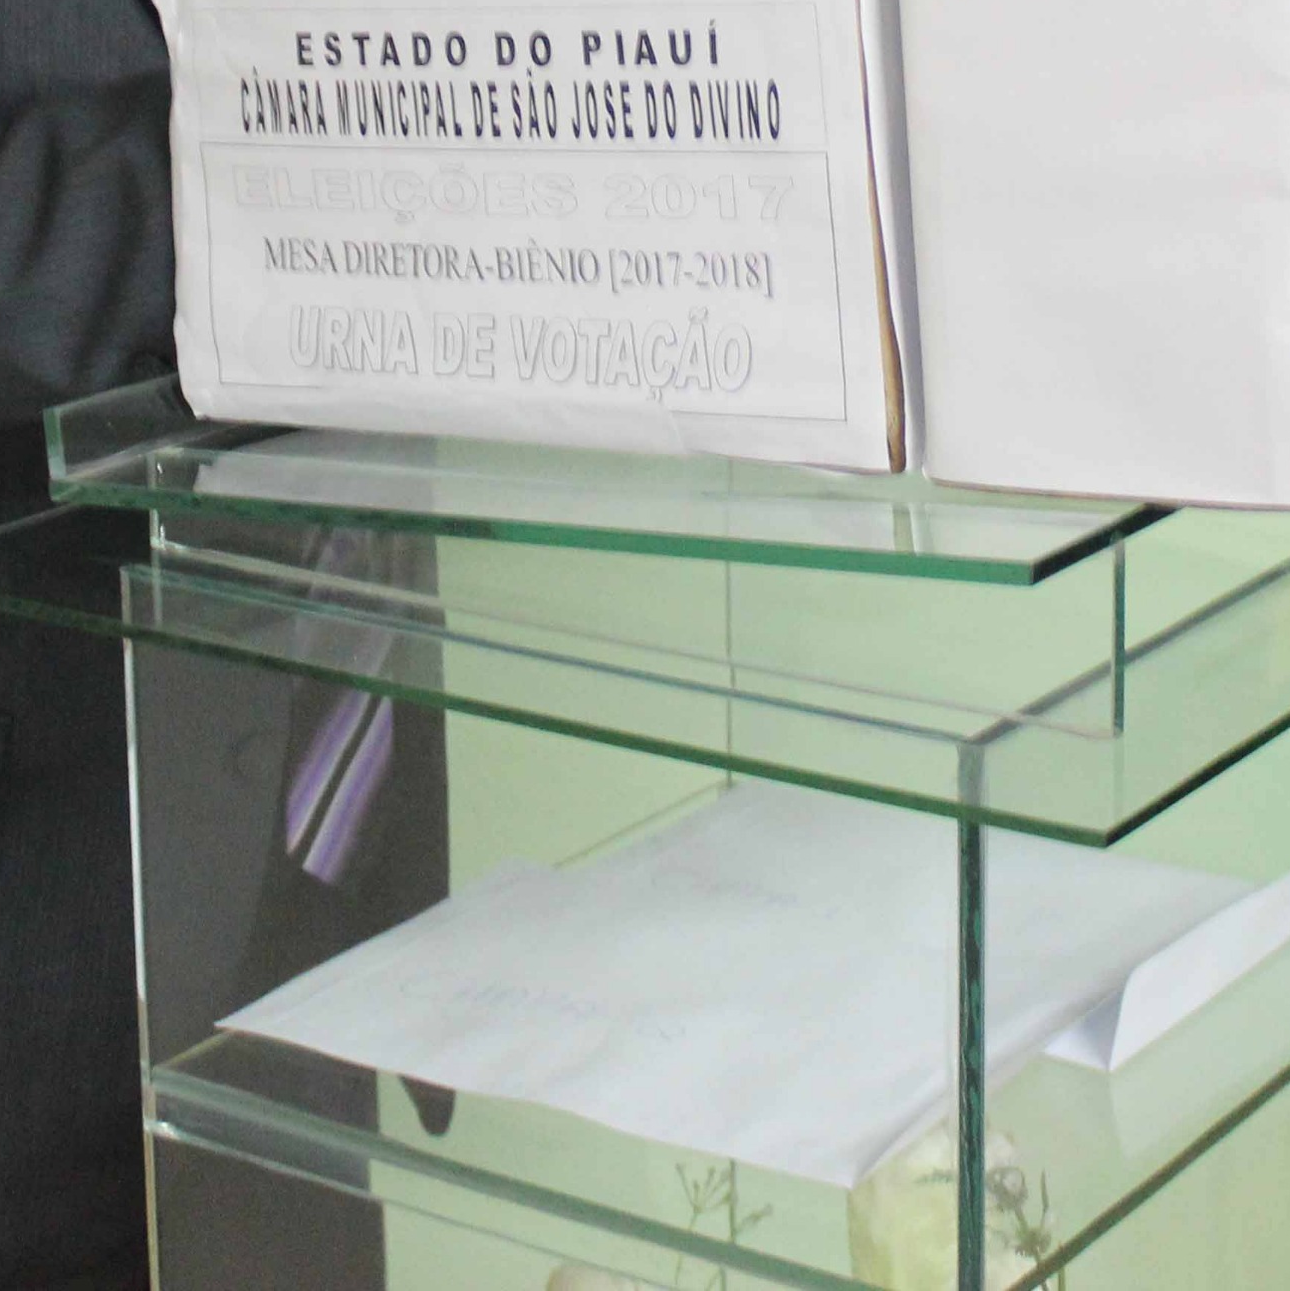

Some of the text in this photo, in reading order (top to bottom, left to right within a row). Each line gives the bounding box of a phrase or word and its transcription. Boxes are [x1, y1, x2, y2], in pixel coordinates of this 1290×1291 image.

[295, 17, 719, 67] ESTADO DO PIAUÍ
[240, 65, 329, 137] CÂMARA
[335, 78, 463, 138] MUNICIPAL
[470, 79, 502, 138] DE
[510, 66, 558, 140] SÃO
[643, 78, 678, 140] DO
[688, 78, 781, 141] DIVINO
[231, 160, 797, 225] ELEIÇÕES 2017
[261, 233, 776, 299] MESA DIRETORA-BIÊNIO [2017-2018]
[288, 303, 754, 403] URNA DE VOTAÇÃO
